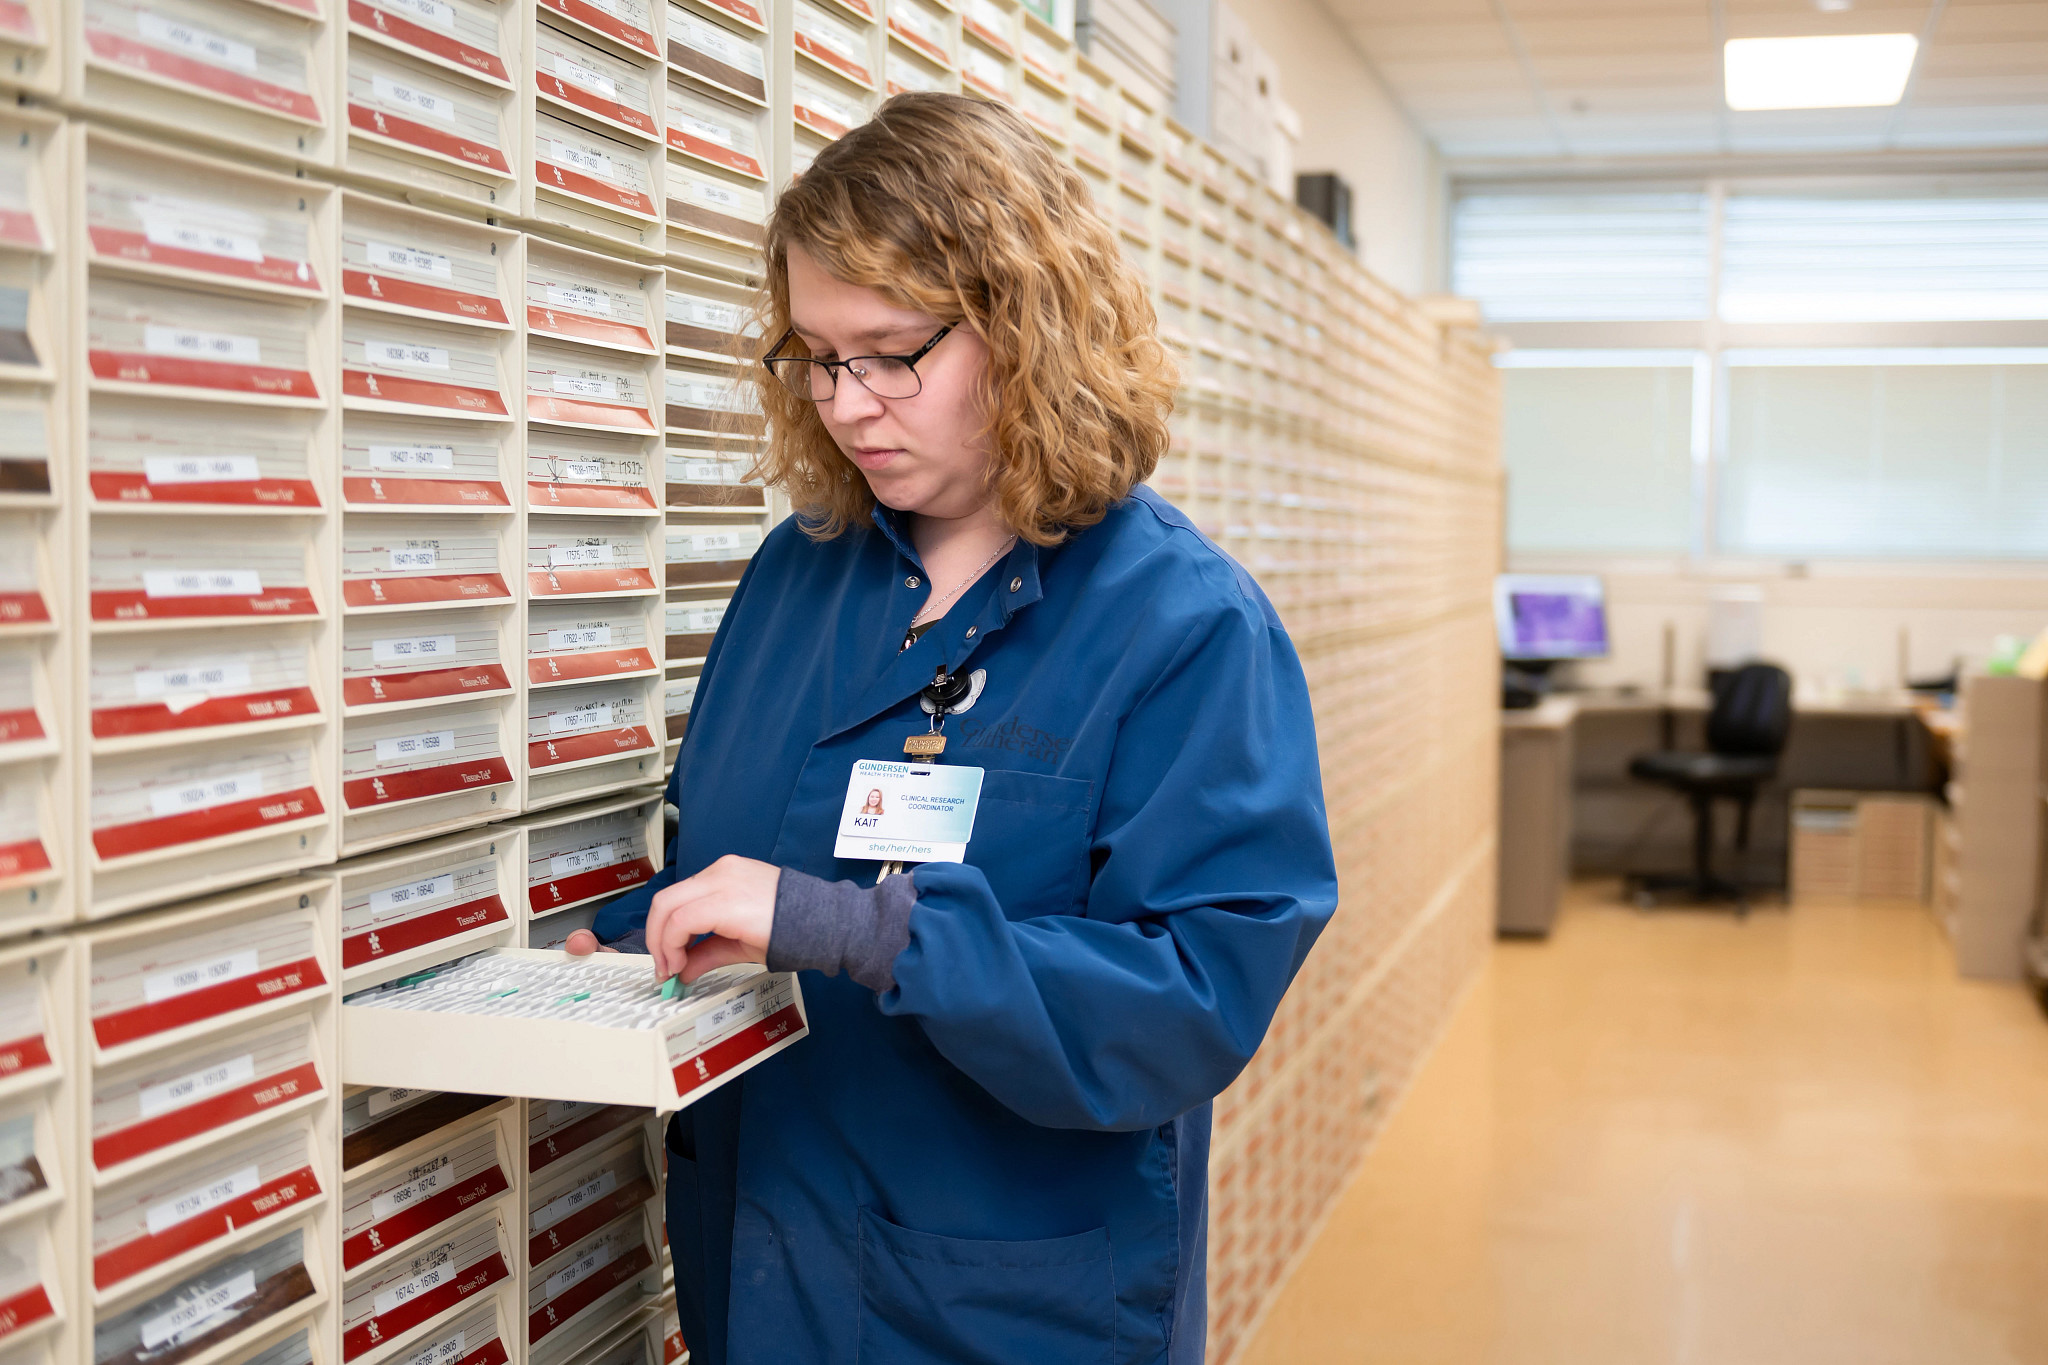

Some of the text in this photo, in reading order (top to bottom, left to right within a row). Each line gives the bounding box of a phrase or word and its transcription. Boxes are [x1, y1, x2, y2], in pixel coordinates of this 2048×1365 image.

[859, 762, 909, 773] GUNDERSEN
[901, 794, 929, 803] CLINICAL
[908, 803, 954, 812] COORDINATOR
[854, 817, 878, 827] KAIT
[869, 843, 932, 854] she/her/hers
[418, 1175, 436, 1193] 16742
[395, 1284, 415, 1301] 16743
[420, 1271, 440, 1288] 16768
